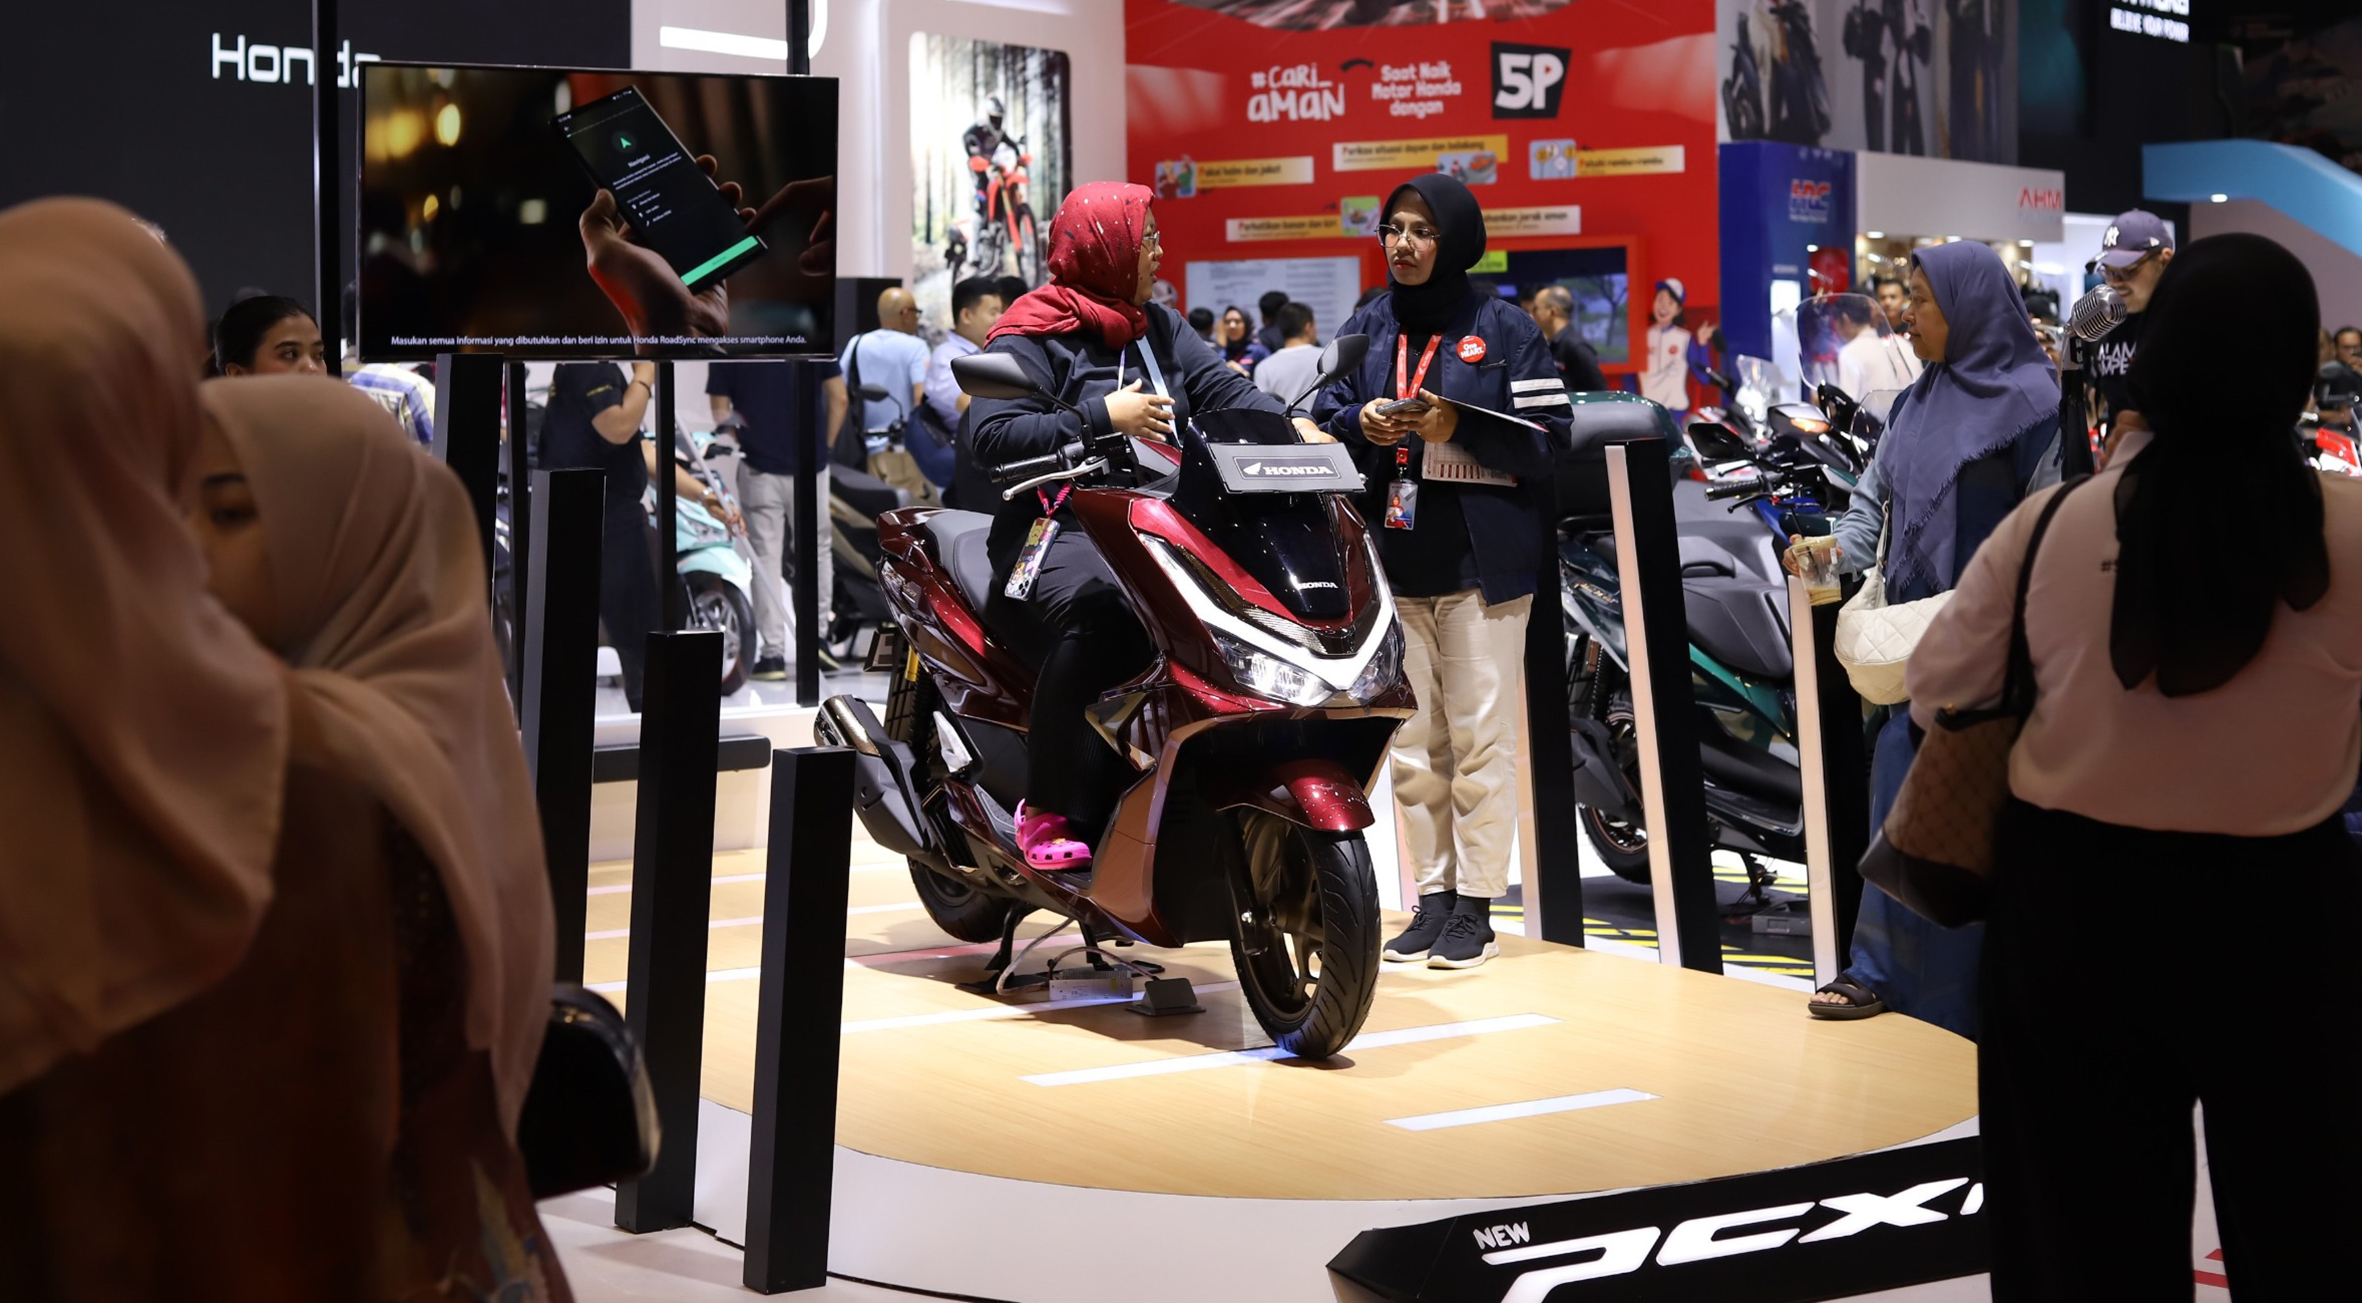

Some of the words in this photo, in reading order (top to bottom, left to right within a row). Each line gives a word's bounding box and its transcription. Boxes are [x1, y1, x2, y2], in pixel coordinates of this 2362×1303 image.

[1381, 65, 1417, 82] Saat
[1418, 61, 1452, 79] Naik
[1494, 52, 1564, 110] 5P
[1372, 83, 1413, 100] Motor
[1416, 79, 1461, 98] Honda
[1390, 100, 1444, 119] dengan
[2018, 187, 2063, 210] AHM
[391, 336, 427, 346] Masukan
[428, 337, 455, 346] semua
[456, 336, 493, 346] informasi
[494, 337, 514, 348] yang
[515, 335, 560, 346] dibutuhkan
[561, 336, 576, 345] dan
[578, 335, 593, 345] beri
[594, 335, 609, 345] izin
[609, 335, 632, 345] untuk
[633, 335, 658, 345] Honda
[659, 335, 696, 346] RoadSync
[697, 335, 739, 346] mengakses
[739, 335, 785, 346] smartphone
[785, 335, 807, 344] Anda.
[1262, 465, 1334, 476] HONDA
[1297, 581, 1339, 590] HONDA
[1473, 1221, 1530, 1250] NEW
